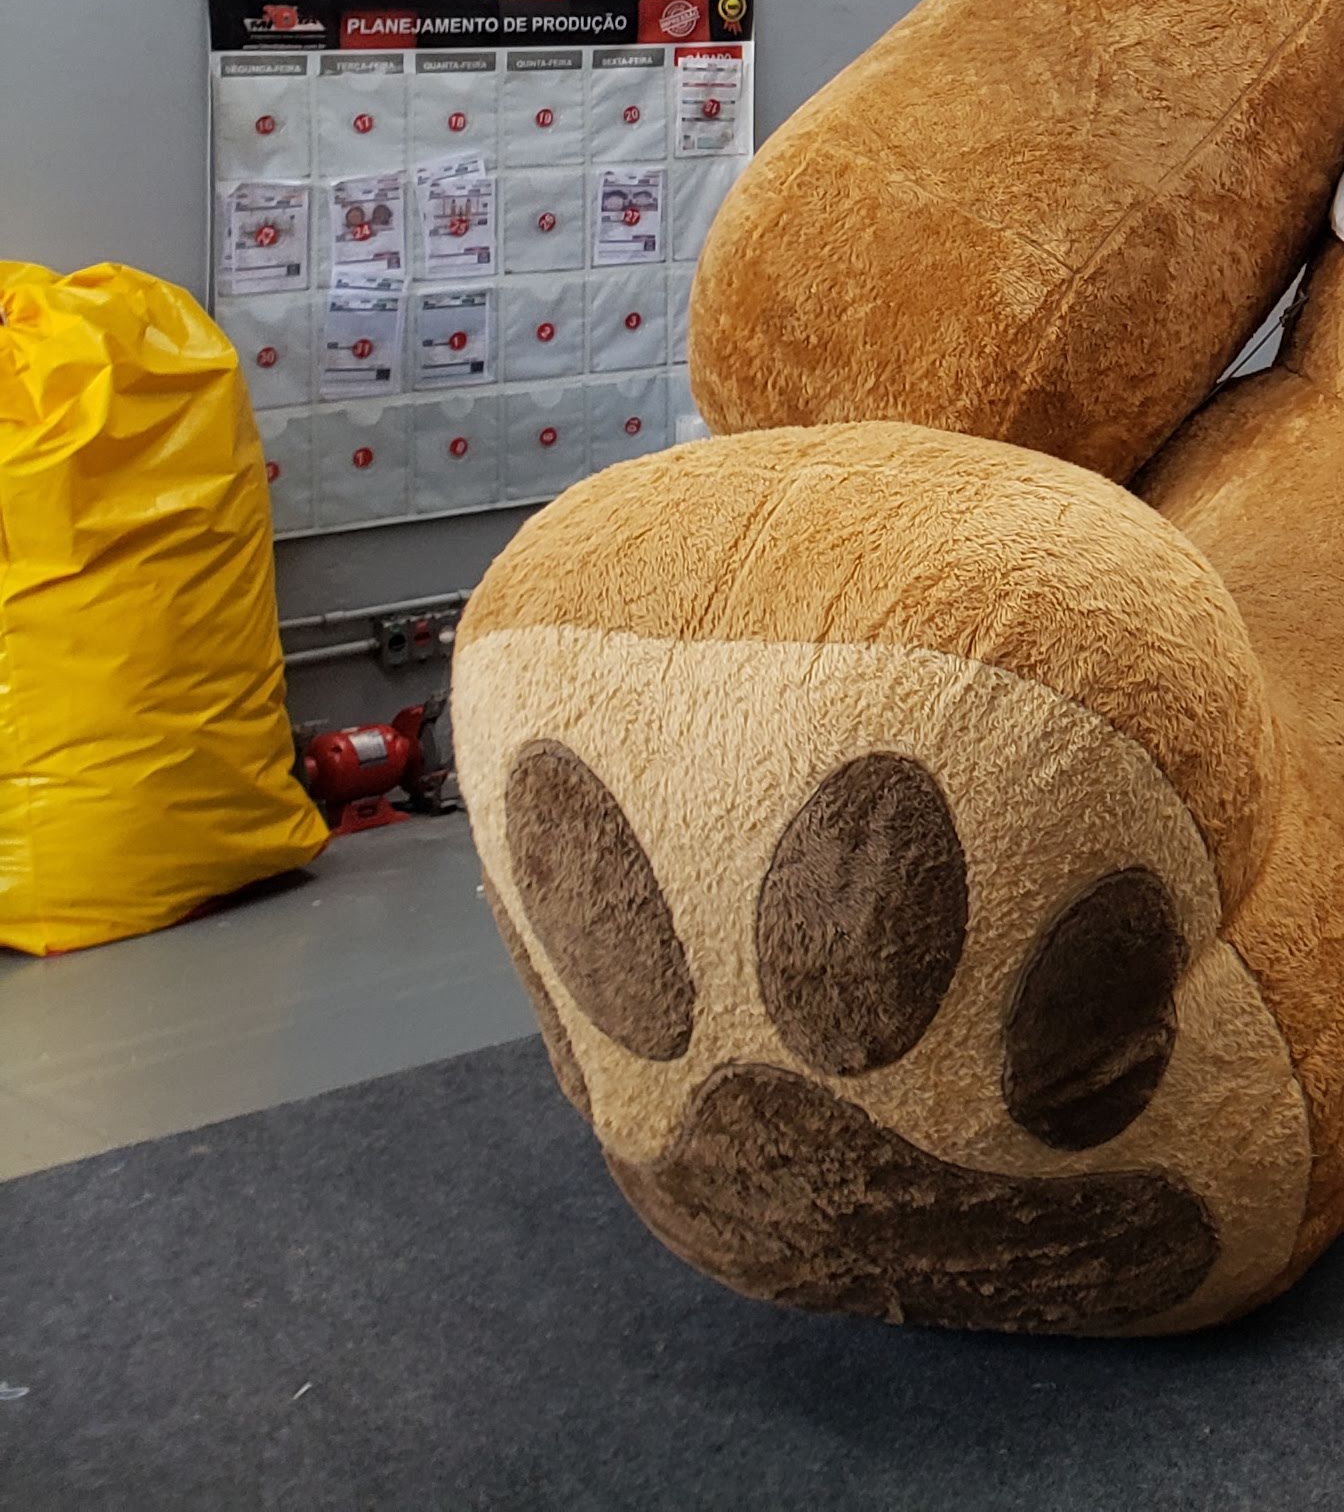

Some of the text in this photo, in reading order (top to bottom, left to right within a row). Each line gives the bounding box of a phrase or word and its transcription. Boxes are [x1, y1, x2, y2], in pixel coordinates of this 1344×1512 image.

[347, 15, 499, 36] PLANEJAMENTO
[503, 16, 528, 33] DE
[531, 12, 628, 35] PRODUÇÃO
